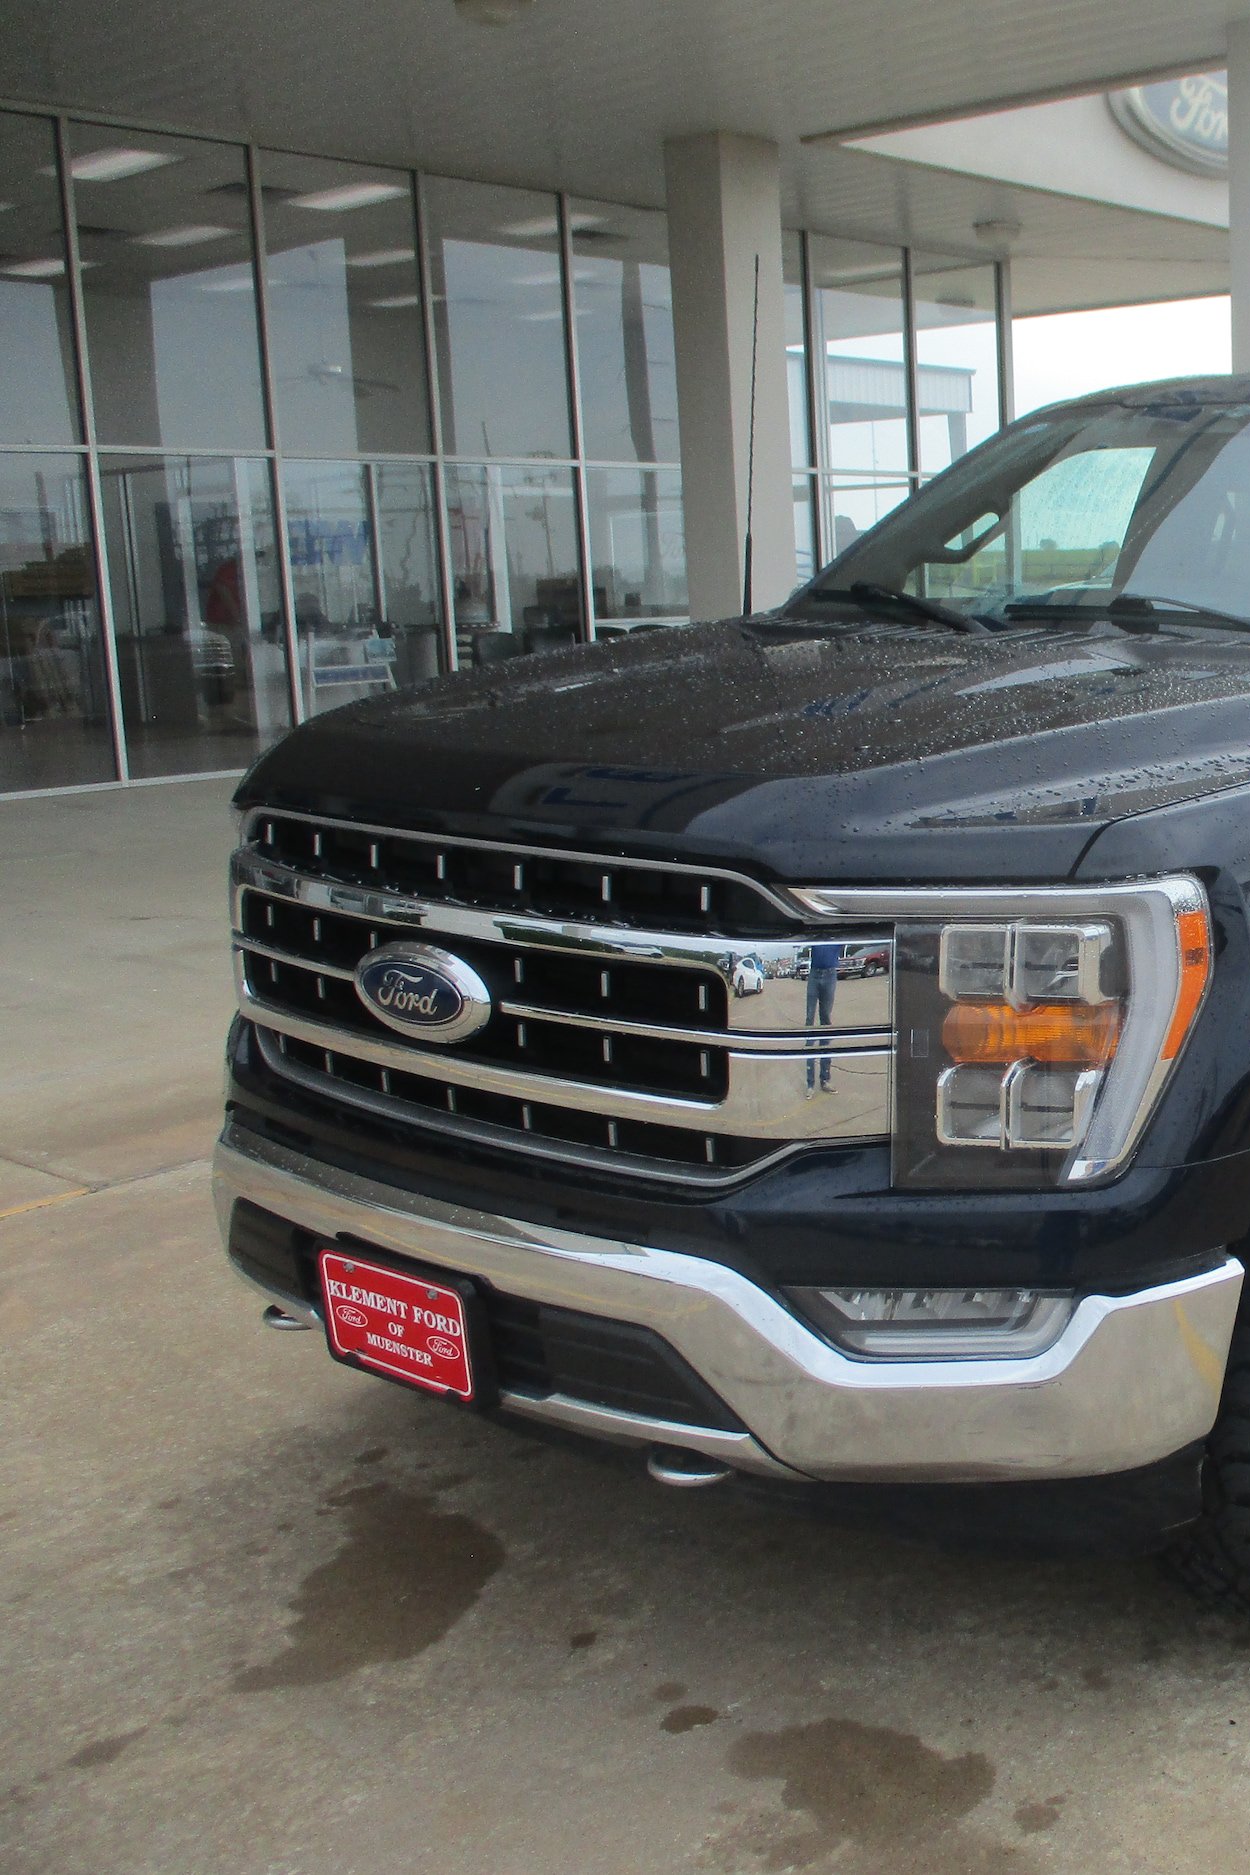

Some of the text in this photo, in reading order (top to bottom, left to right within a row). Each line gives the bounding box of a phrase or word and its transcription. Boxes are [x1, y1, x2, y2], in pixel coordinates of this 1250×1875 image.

[1169, 74, 1228, 140] For
[377, 968, 439, 1016] Ford
[328, 1278, 461, 1338] KLEMENT FORD
[339, 1306, 363, 1325] Ford
[387, 1321, 406, 1338] OF
[431, 1338, 454, 1357] Ford
[366, 1332, 434, 1368] MUENSTER
